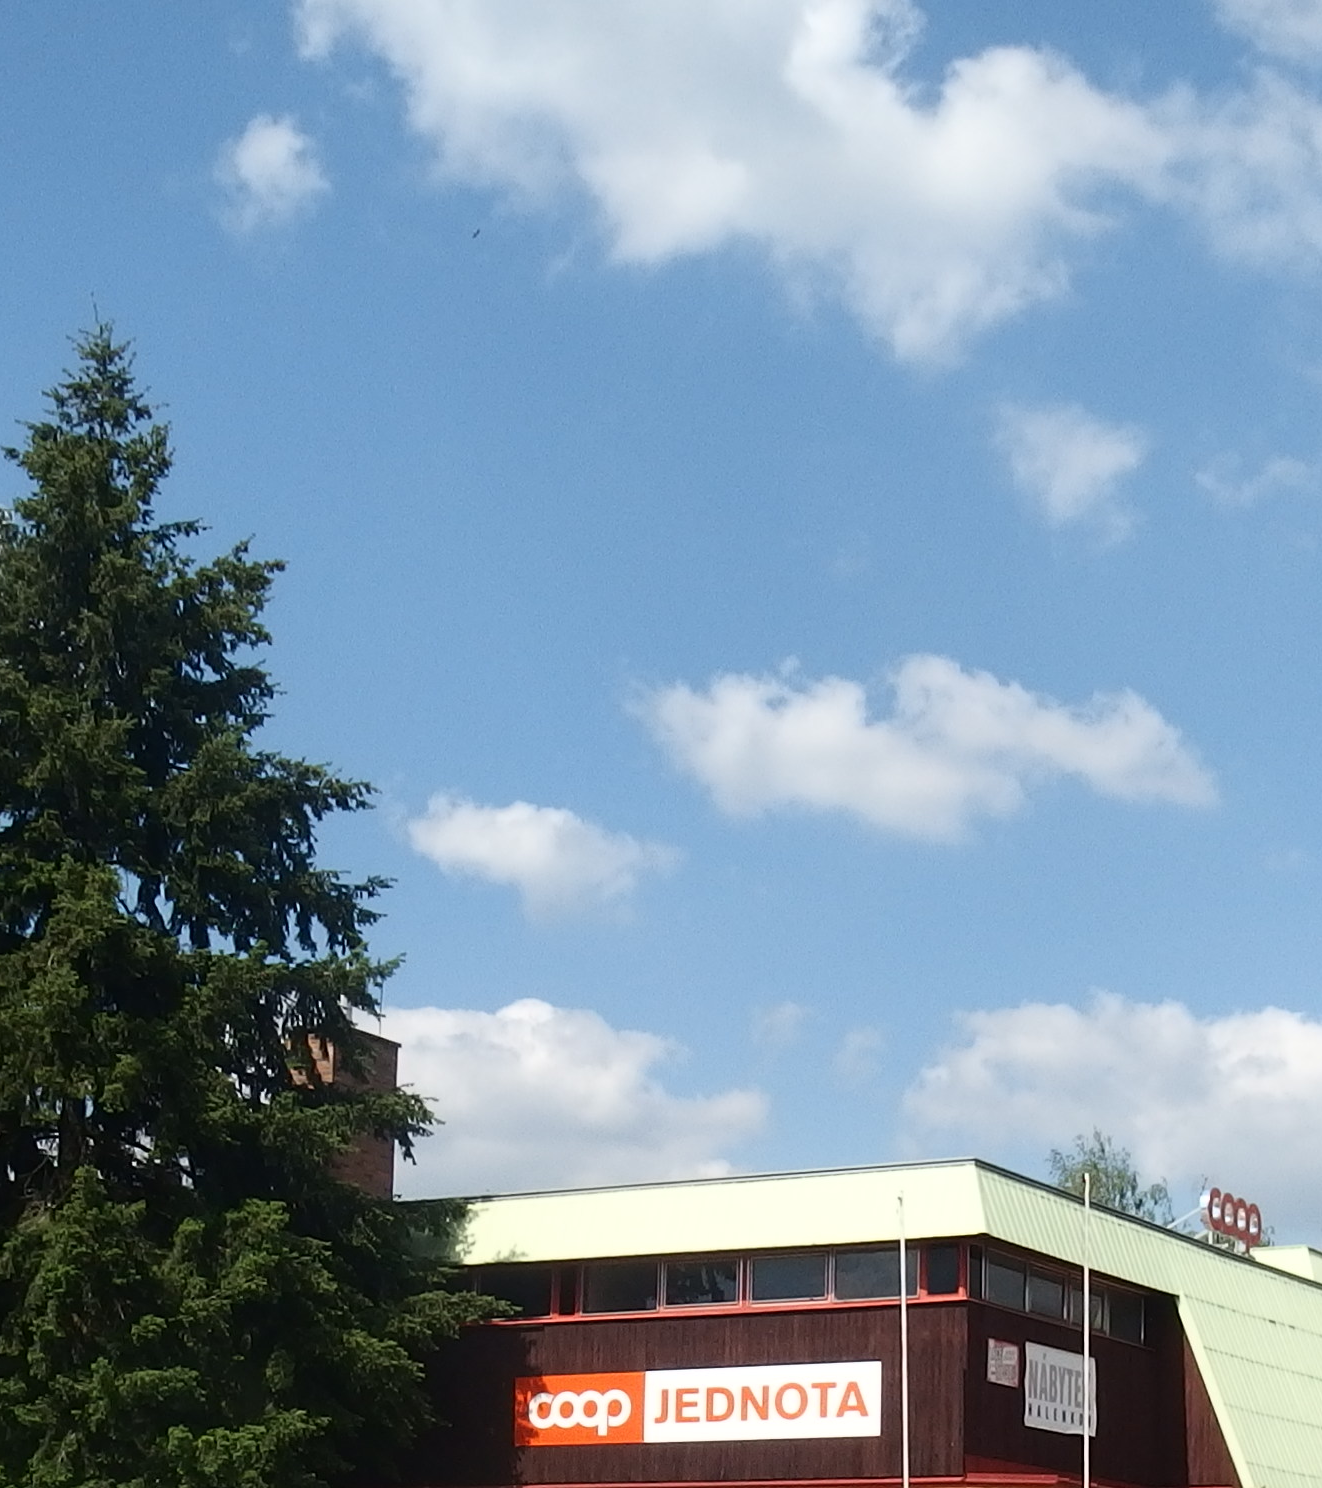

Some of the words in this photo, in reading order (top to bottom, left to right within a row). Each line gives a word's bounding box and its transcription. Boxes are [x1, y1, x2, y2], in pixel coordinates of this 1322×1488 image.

[1208, 1187, 1261, 1254] coop
[528, 1389, 632, 1436] coop
[654, 1381, 869, 1424] JEDNOTA
